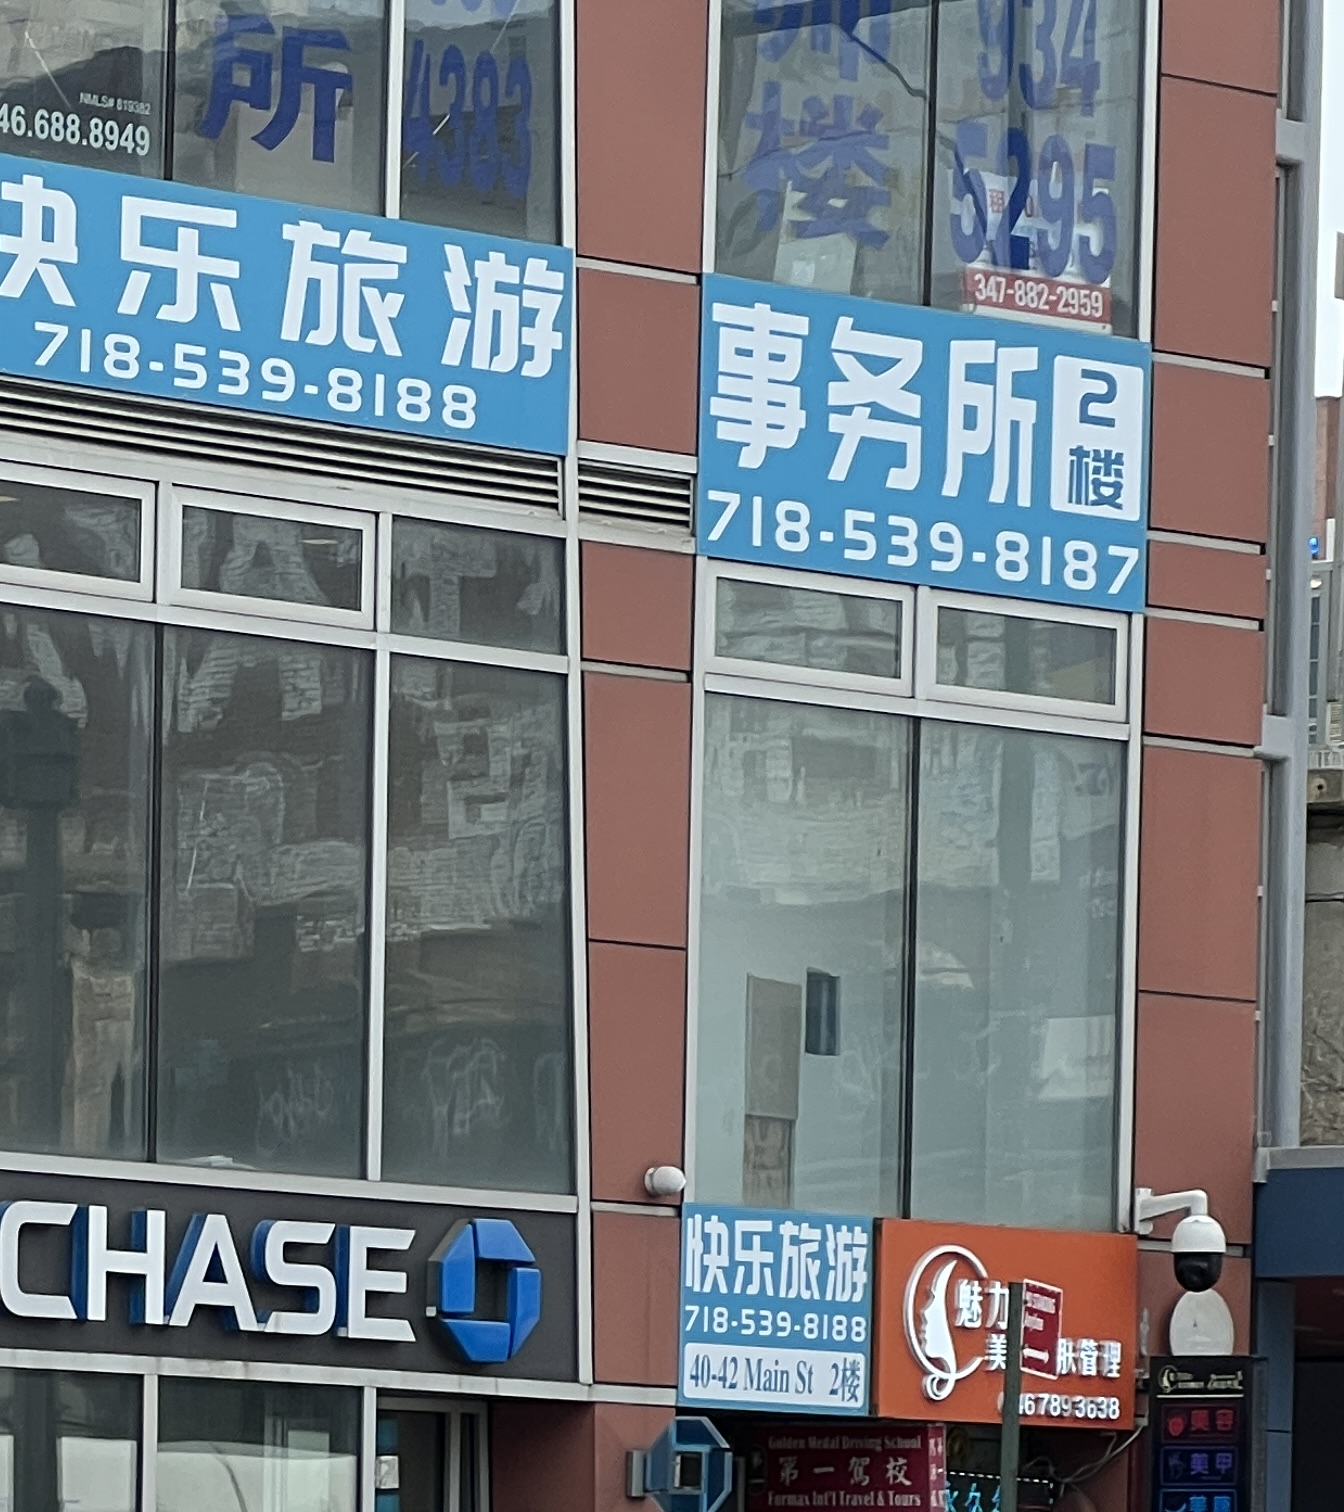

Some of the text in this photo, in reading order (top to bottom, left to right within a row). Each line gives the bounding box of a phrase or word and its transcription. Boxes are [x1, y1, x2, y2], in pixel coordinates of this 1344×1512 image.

[974, 273, 1104, 318] 347-882-2959
[33, 320, 477, 430] 718-539-8188
[709, 302, 1039, 507] 事务所
[1068, 368, 1125, 511] 2楼
[707, 490, 1140, 595] 718-539-8187
[685, 1213, 869, 1304] 快乐旅游
[685, 1306, 867, 1343] 718-539-8188
[689, 1354, 740, 1386] 40-42
[744, 1356, 791, 1393] Main
[795, 1359, 814, 1396] St
